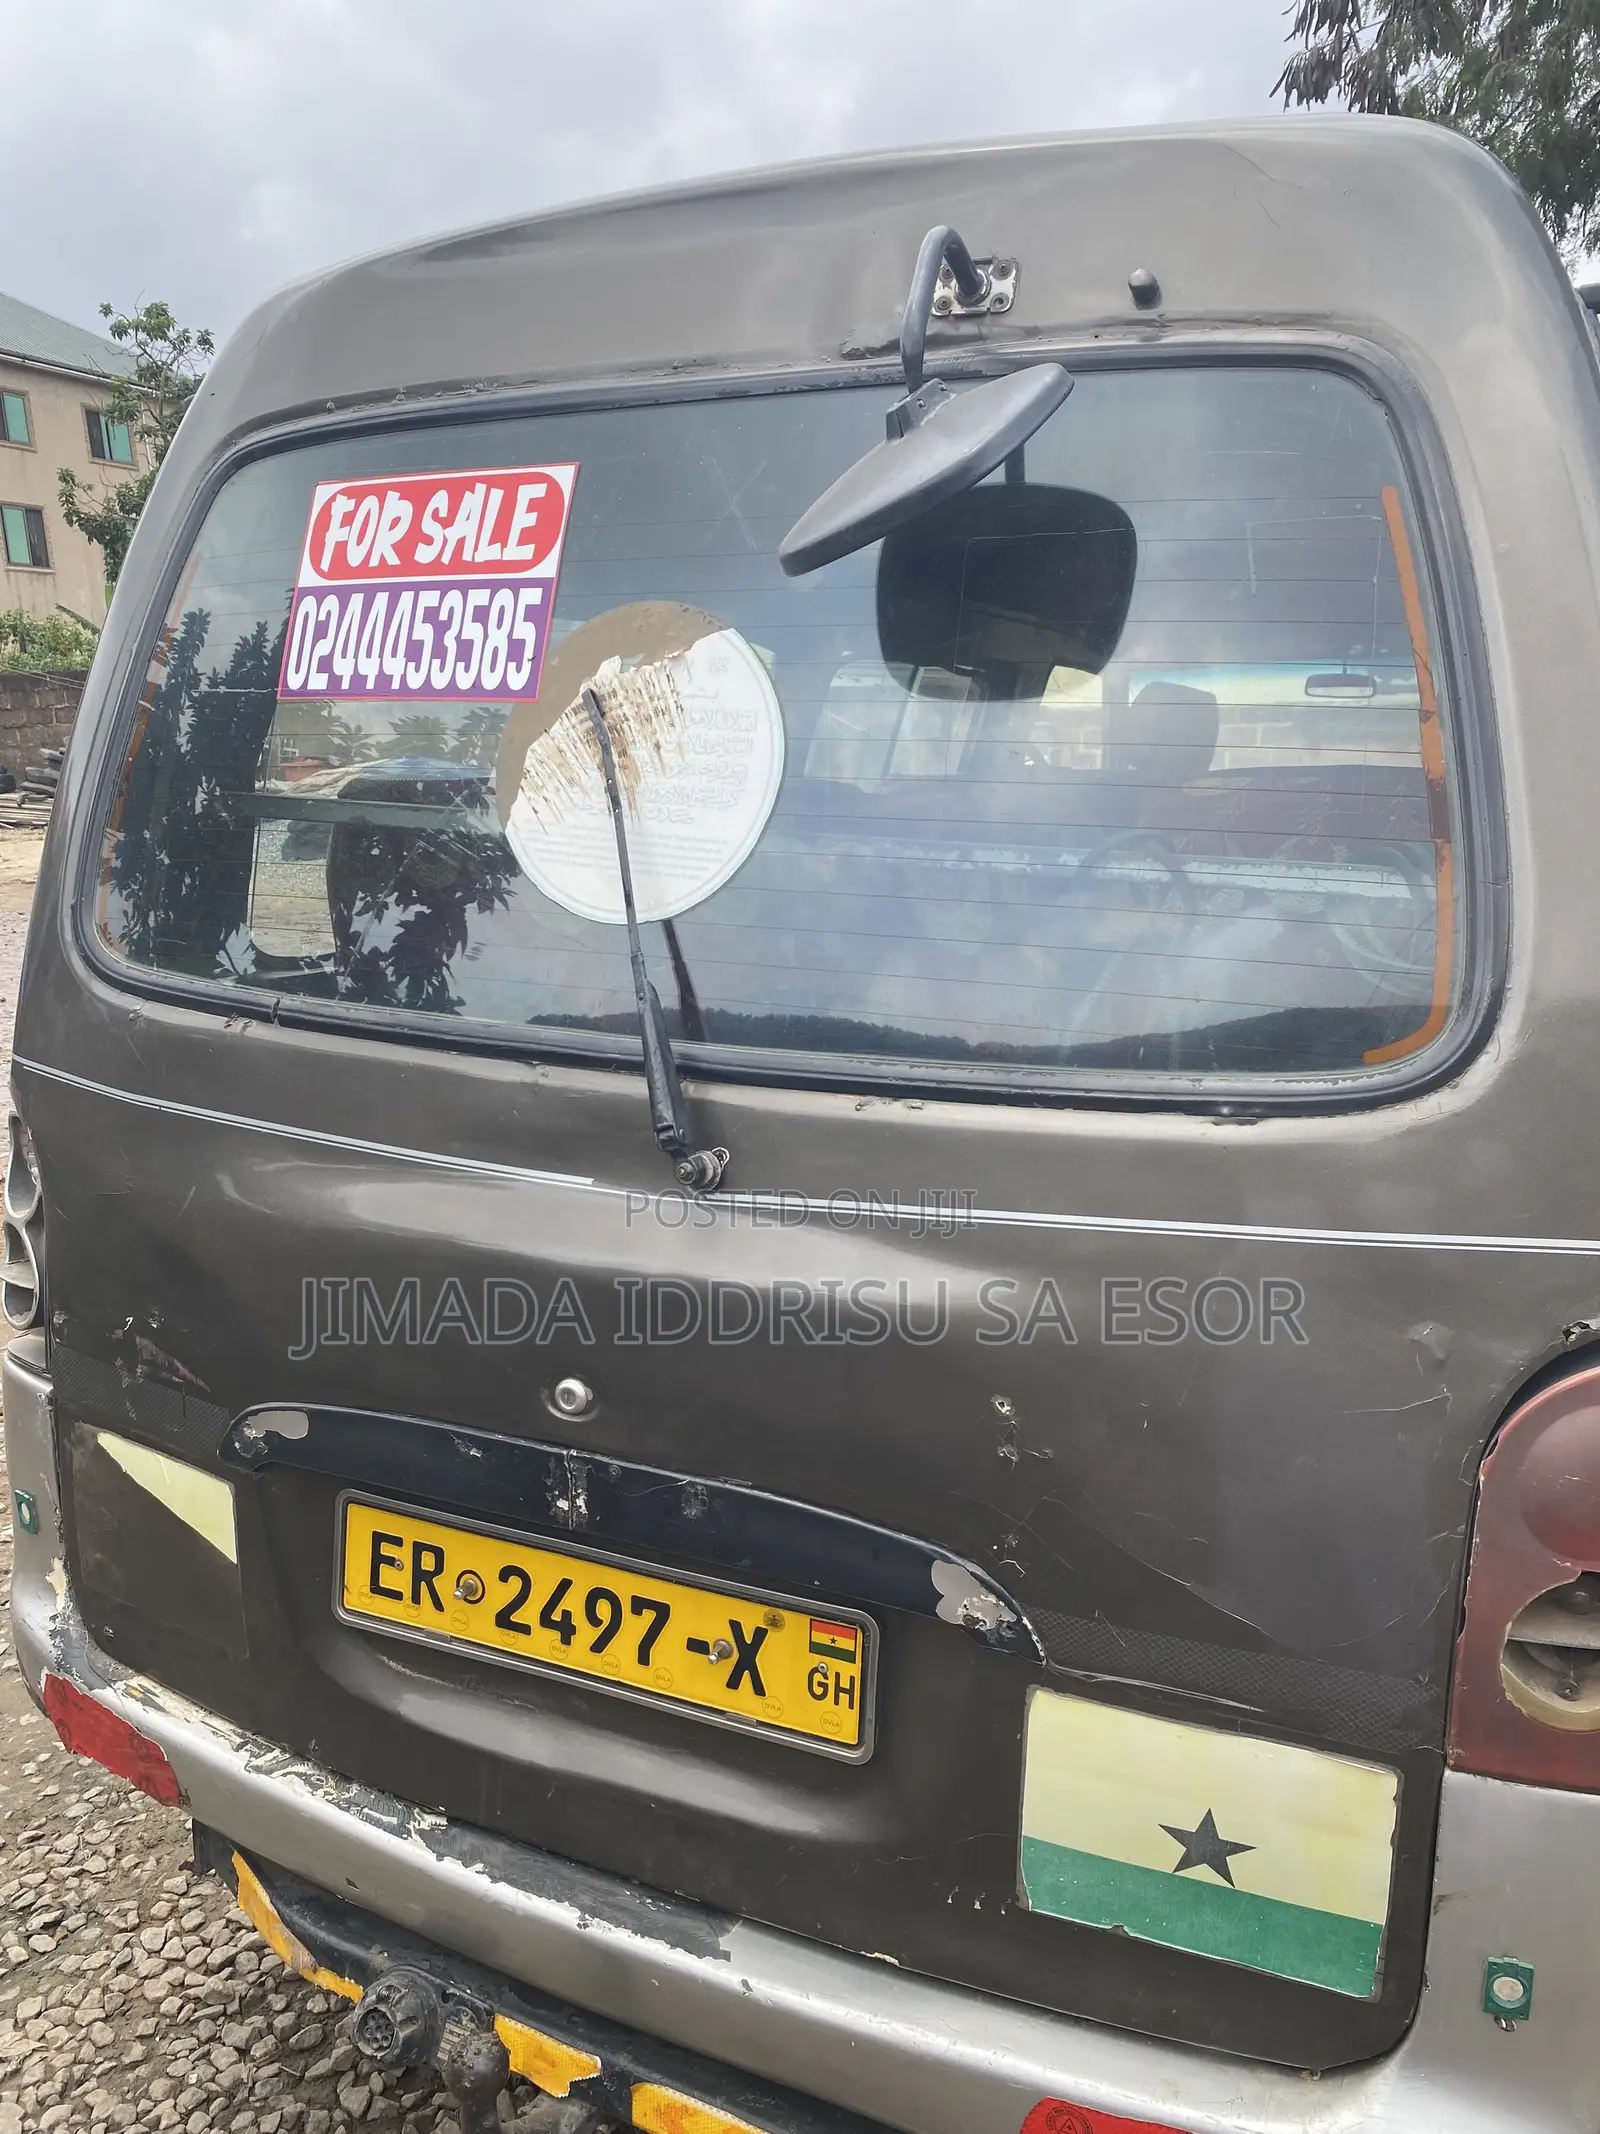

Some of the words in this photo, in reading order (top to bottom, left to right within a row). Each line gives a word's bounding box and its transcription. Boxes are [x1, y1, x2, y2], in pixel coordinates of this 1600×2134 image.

[319, 489, 414, 573] FOR
[413, 482, 548, 566] SALE
[286, 587, 544, 690] 0244453585
[369, 1529, 445, 1613] ER
[807, 1665, 856, 1711] GH
